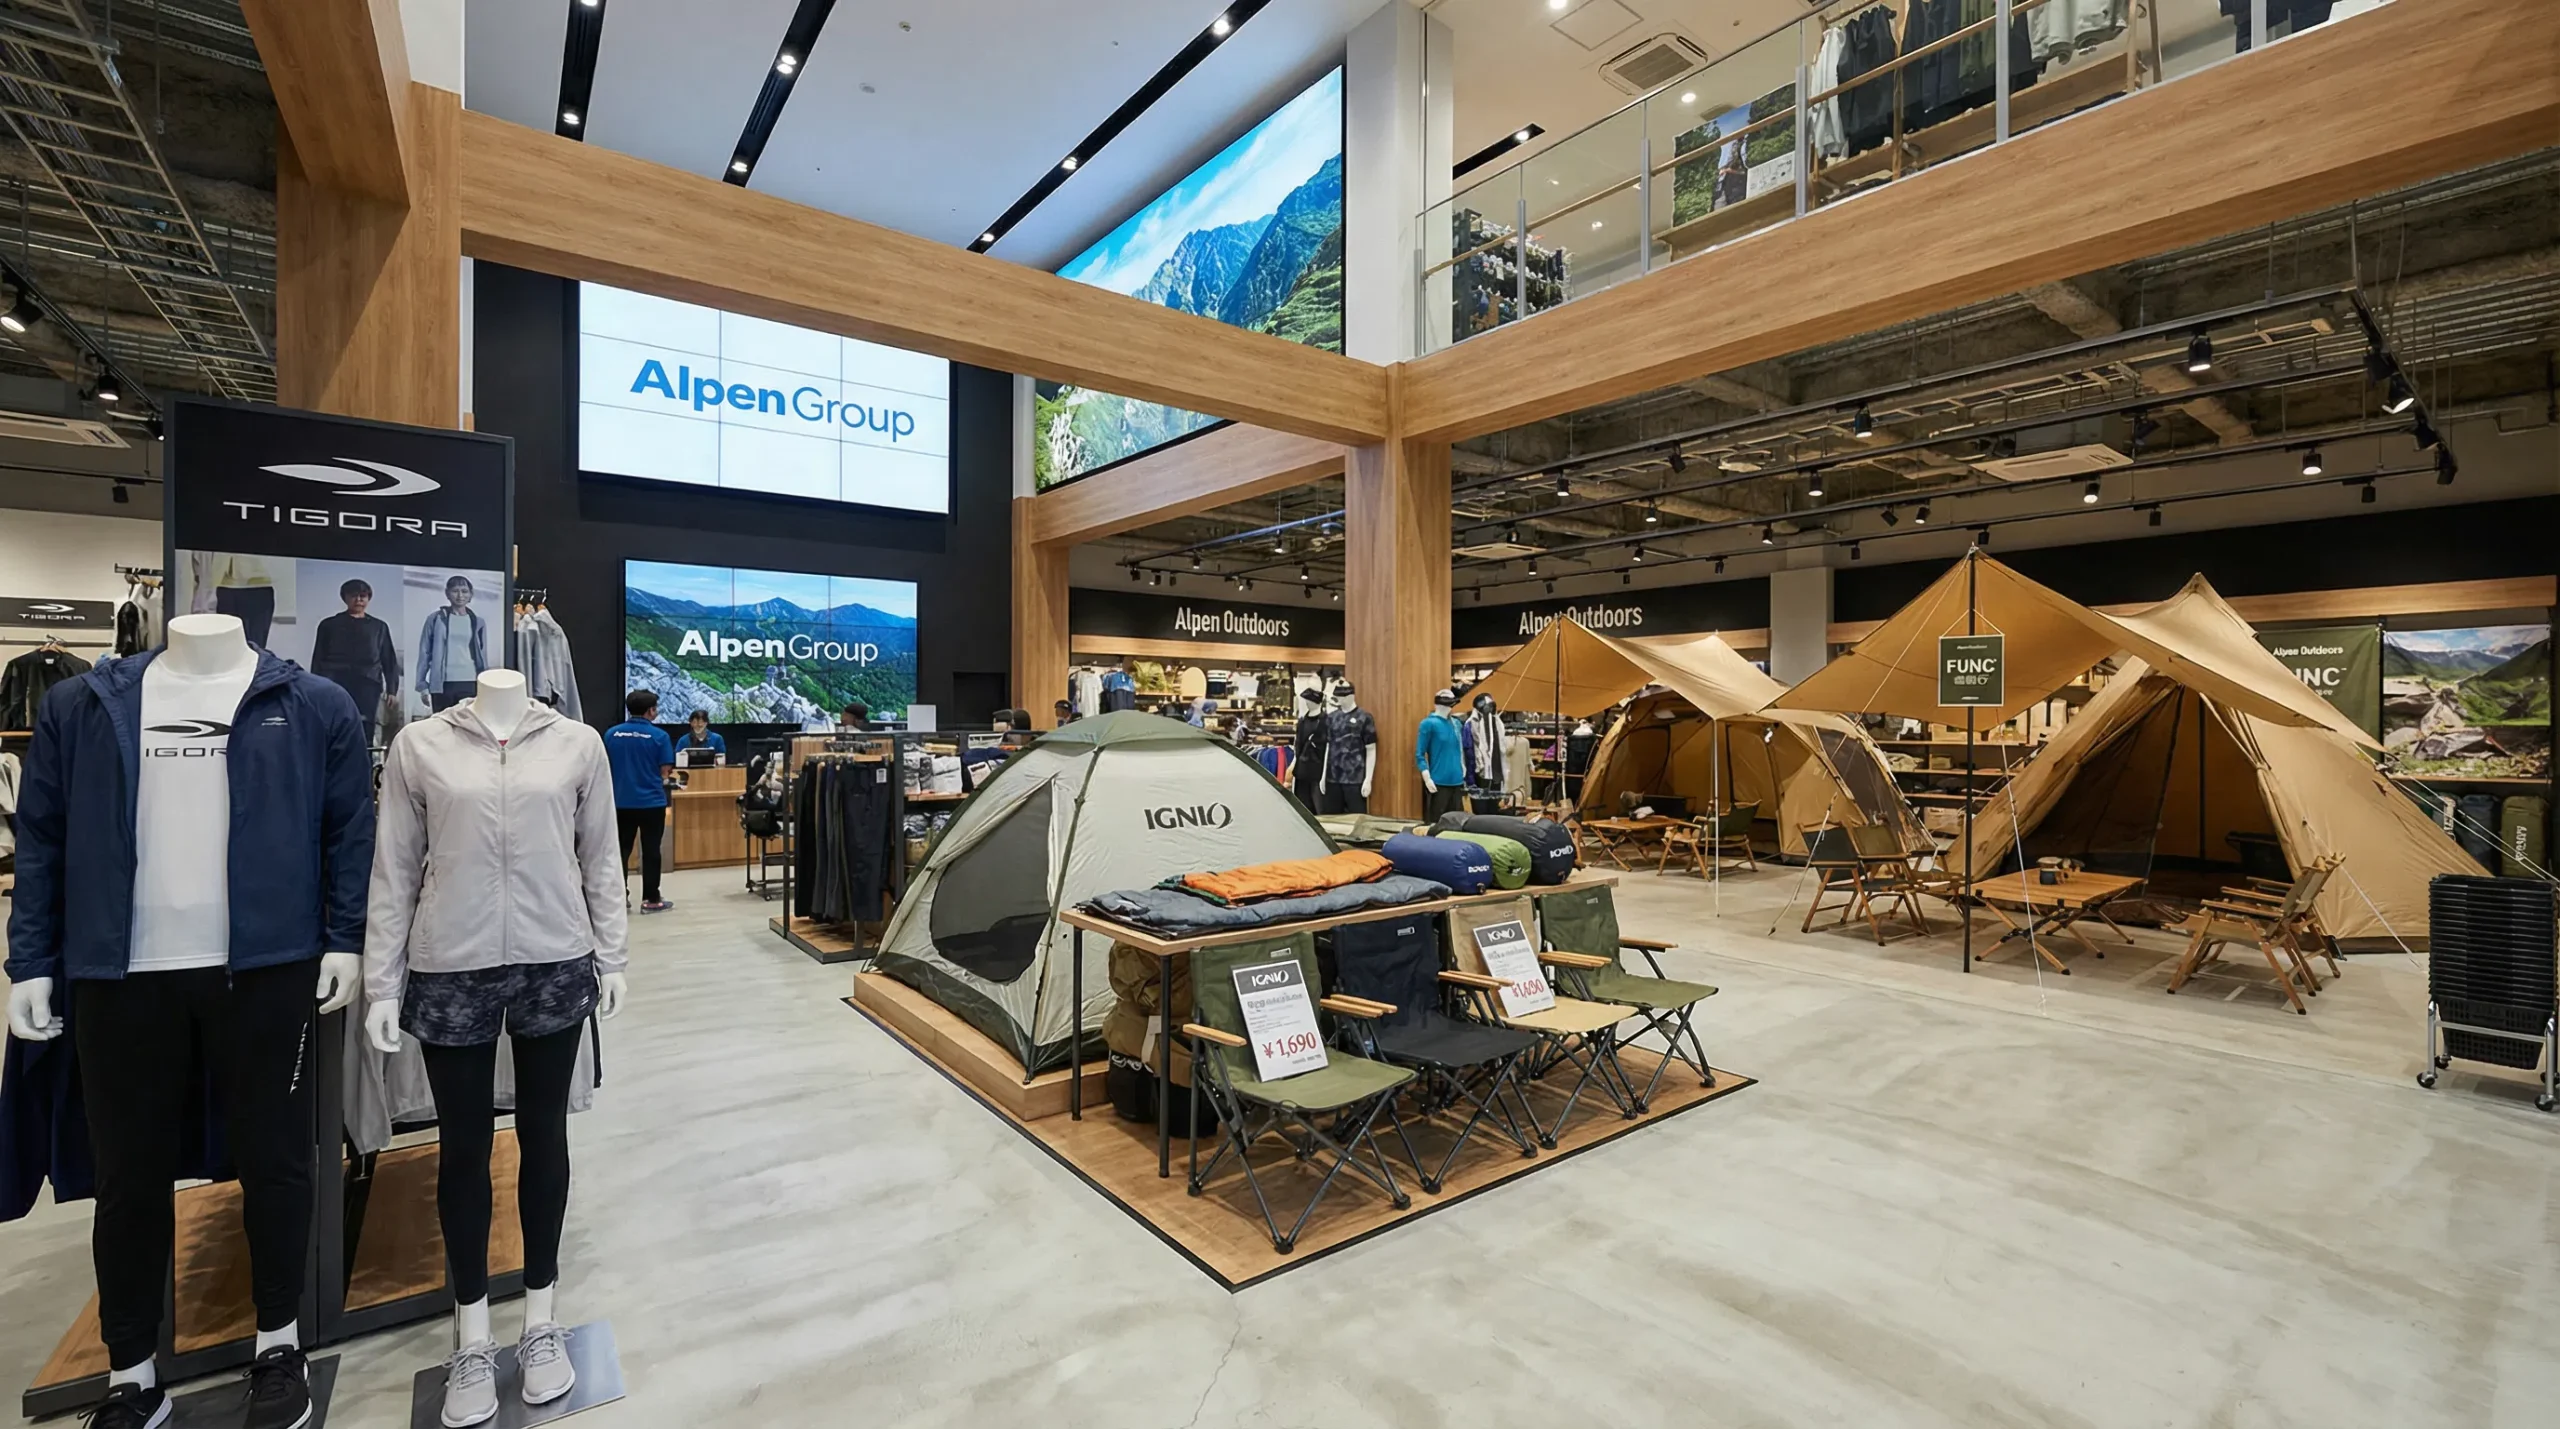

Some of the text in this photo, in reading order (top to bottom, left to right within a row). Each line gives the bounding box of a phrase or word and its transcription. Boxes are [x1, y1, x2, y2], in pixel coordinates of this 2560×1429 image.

[629, 358, 915, 443] Alpen Group
[222, 501, 468, 538] TIGORA
[1174, 606, 1290, 637] Alpen Outdoors
[1518, 611, 1558, 636] Alpe
[676, 629, 879, 667] Alpen Group
[1946, 658, 1996, 674] FUNC
[2295, 667, 2341, 687] NC
[145, 747, 228, 758] IGOR
[1143, 802, 1233, 830] IGNIO
